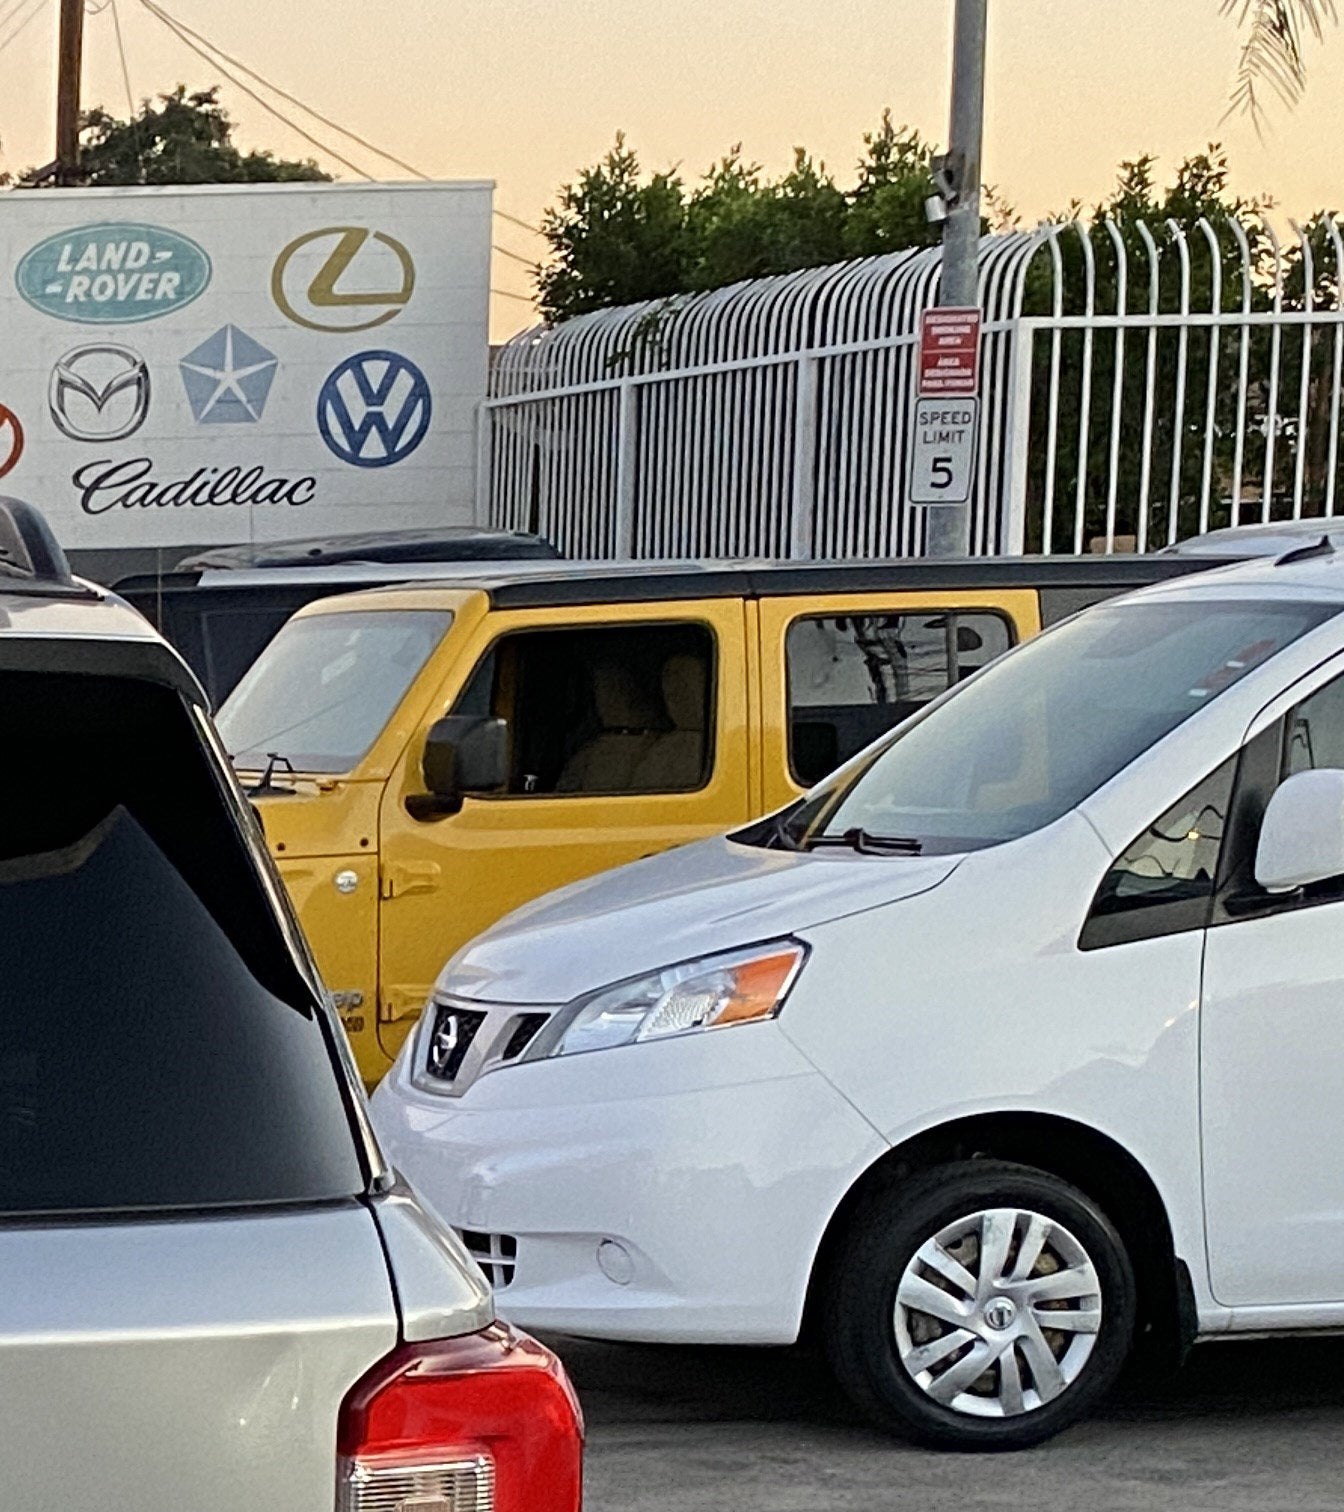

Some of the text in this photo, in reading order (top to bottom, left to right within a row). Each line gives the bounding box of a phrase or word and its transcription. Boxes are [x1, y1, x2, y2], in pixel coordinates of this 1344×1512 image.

[919, 411, 971, 425] SPEED
[923, 430, 965, 444] LIMIT
[930, 456, 953, 488] 5
[72, 458, 316, 514] Cadillac
